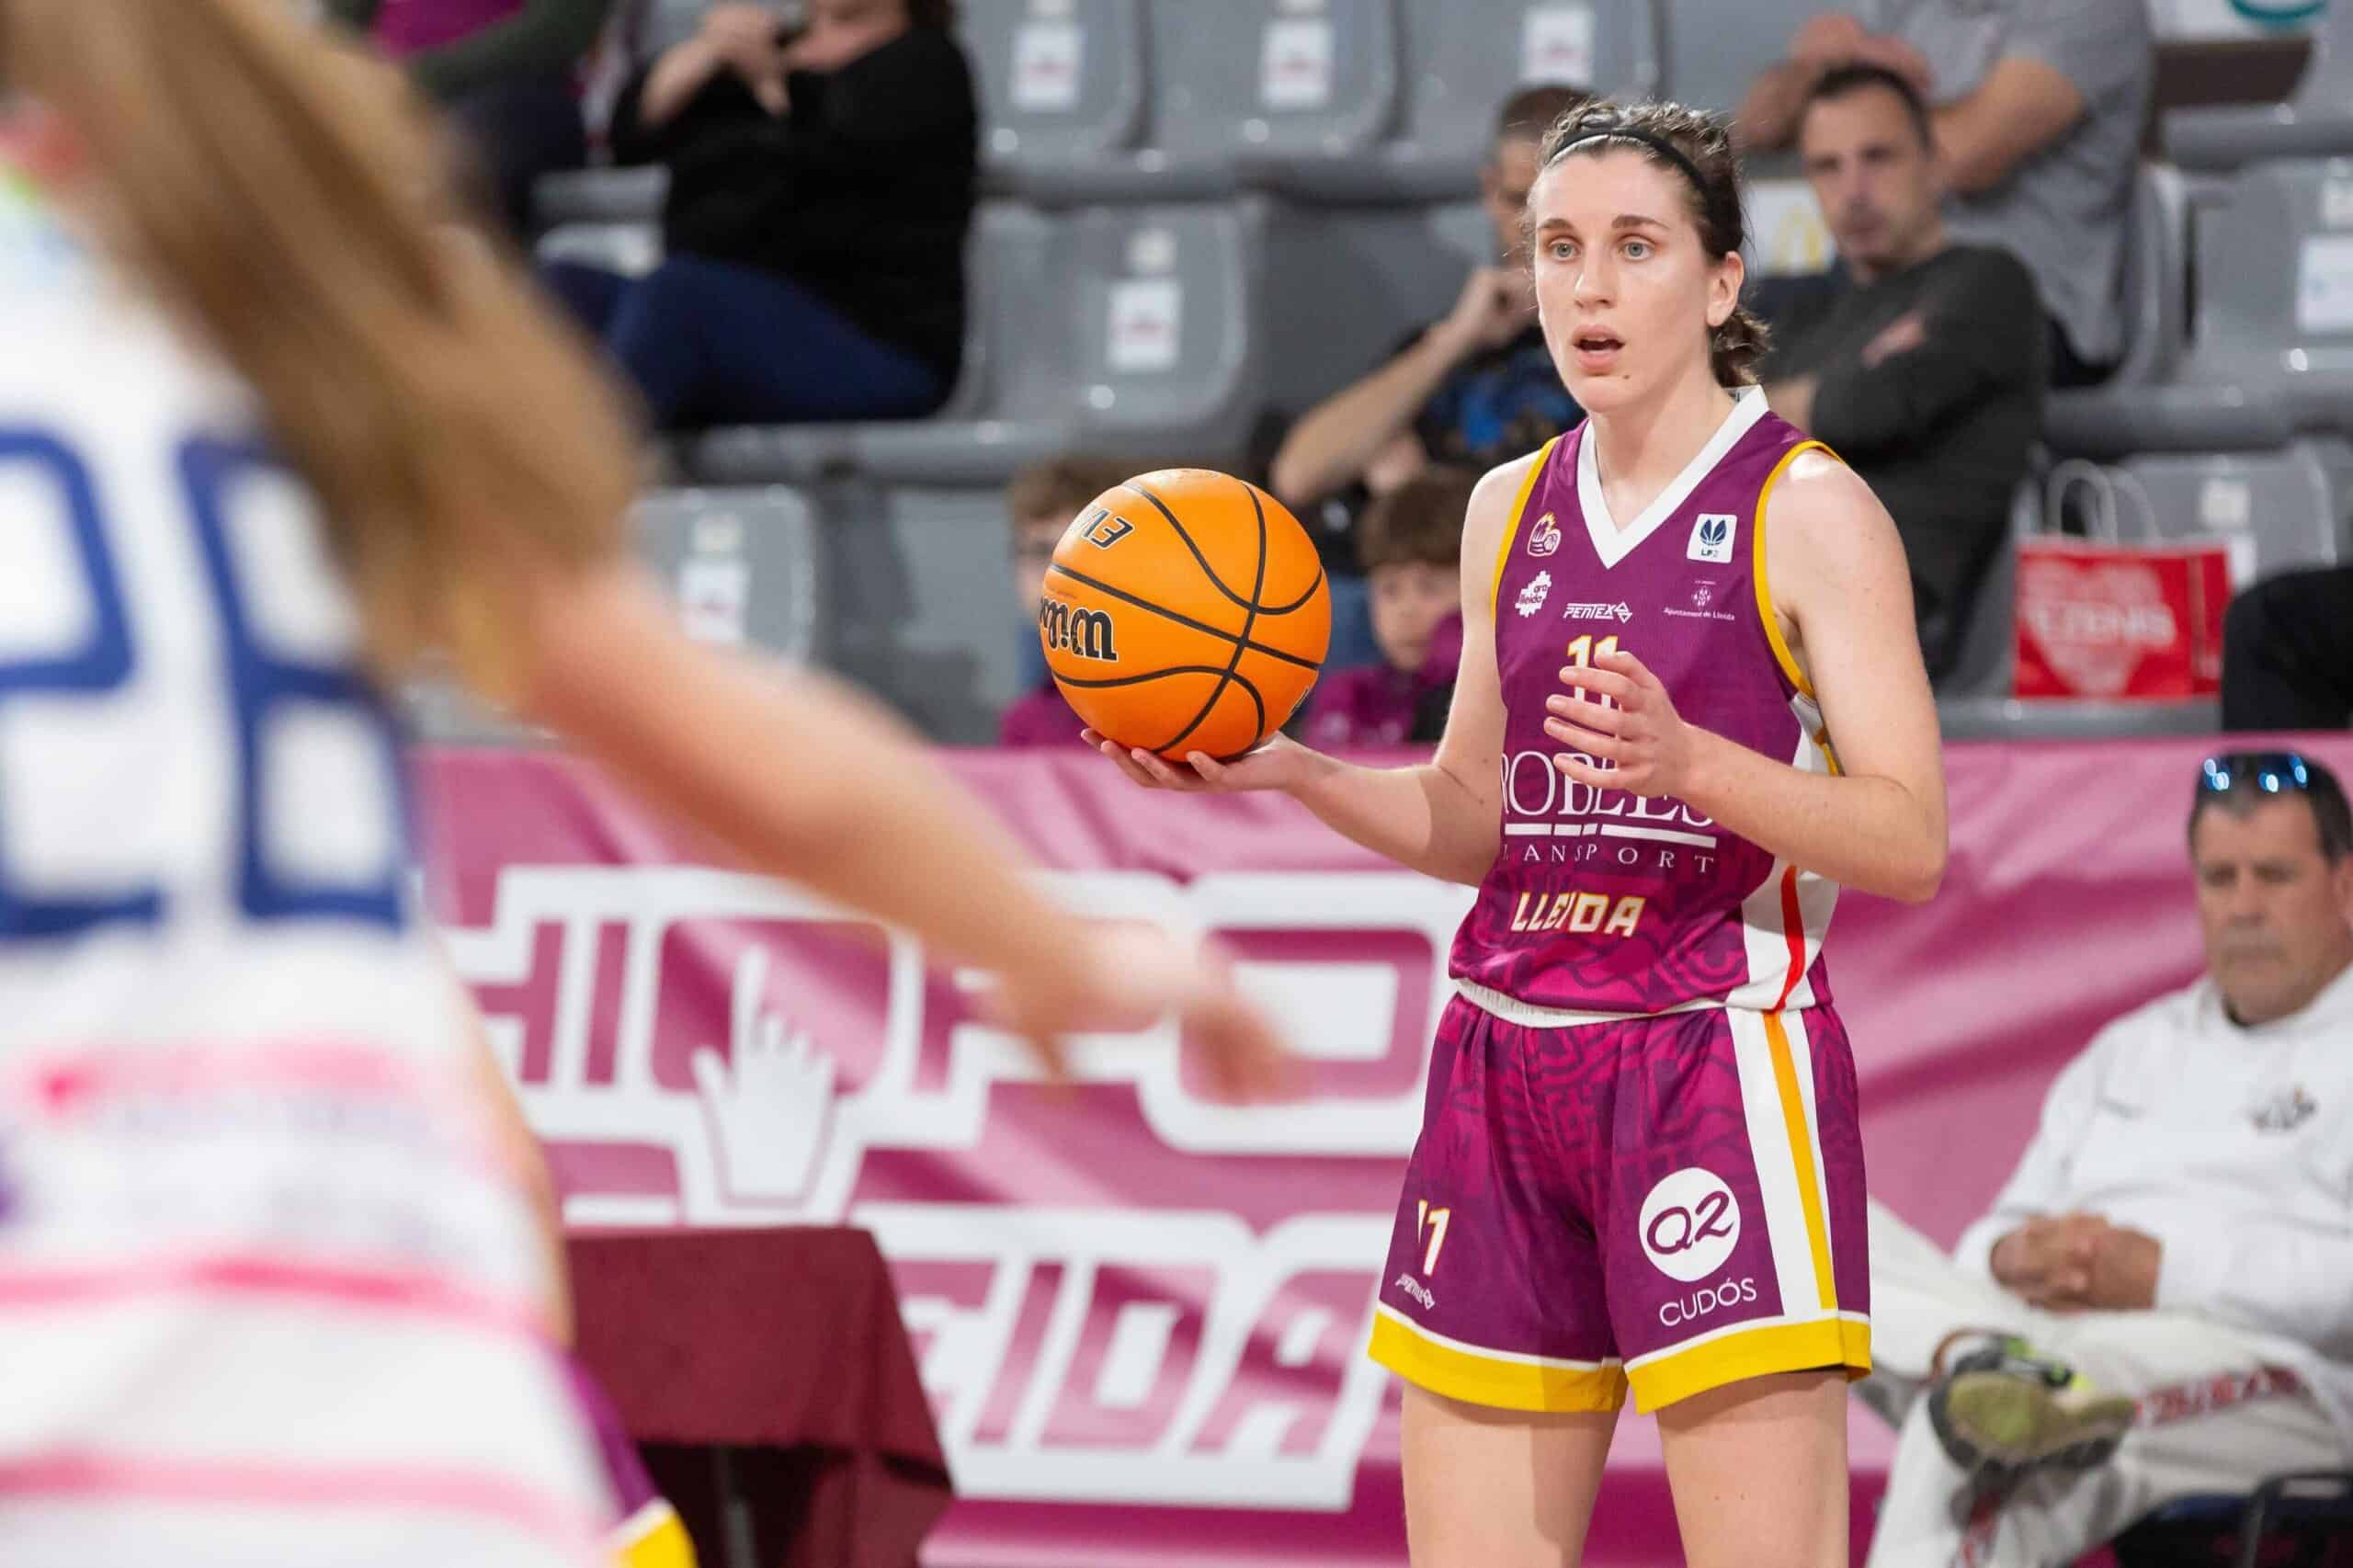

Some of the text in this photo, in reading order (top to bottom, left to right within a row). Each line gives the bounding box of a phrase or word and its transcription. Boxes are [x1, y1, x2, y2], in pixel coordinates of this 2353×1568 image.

[1563, 603, 1617, 620] PENTEX
[1510, 892, 1646, 937] LLEIDA
[1646, 1190, 1735, 1256] Q2
[1659, 1277, 1757, 1327] CUDÓS
